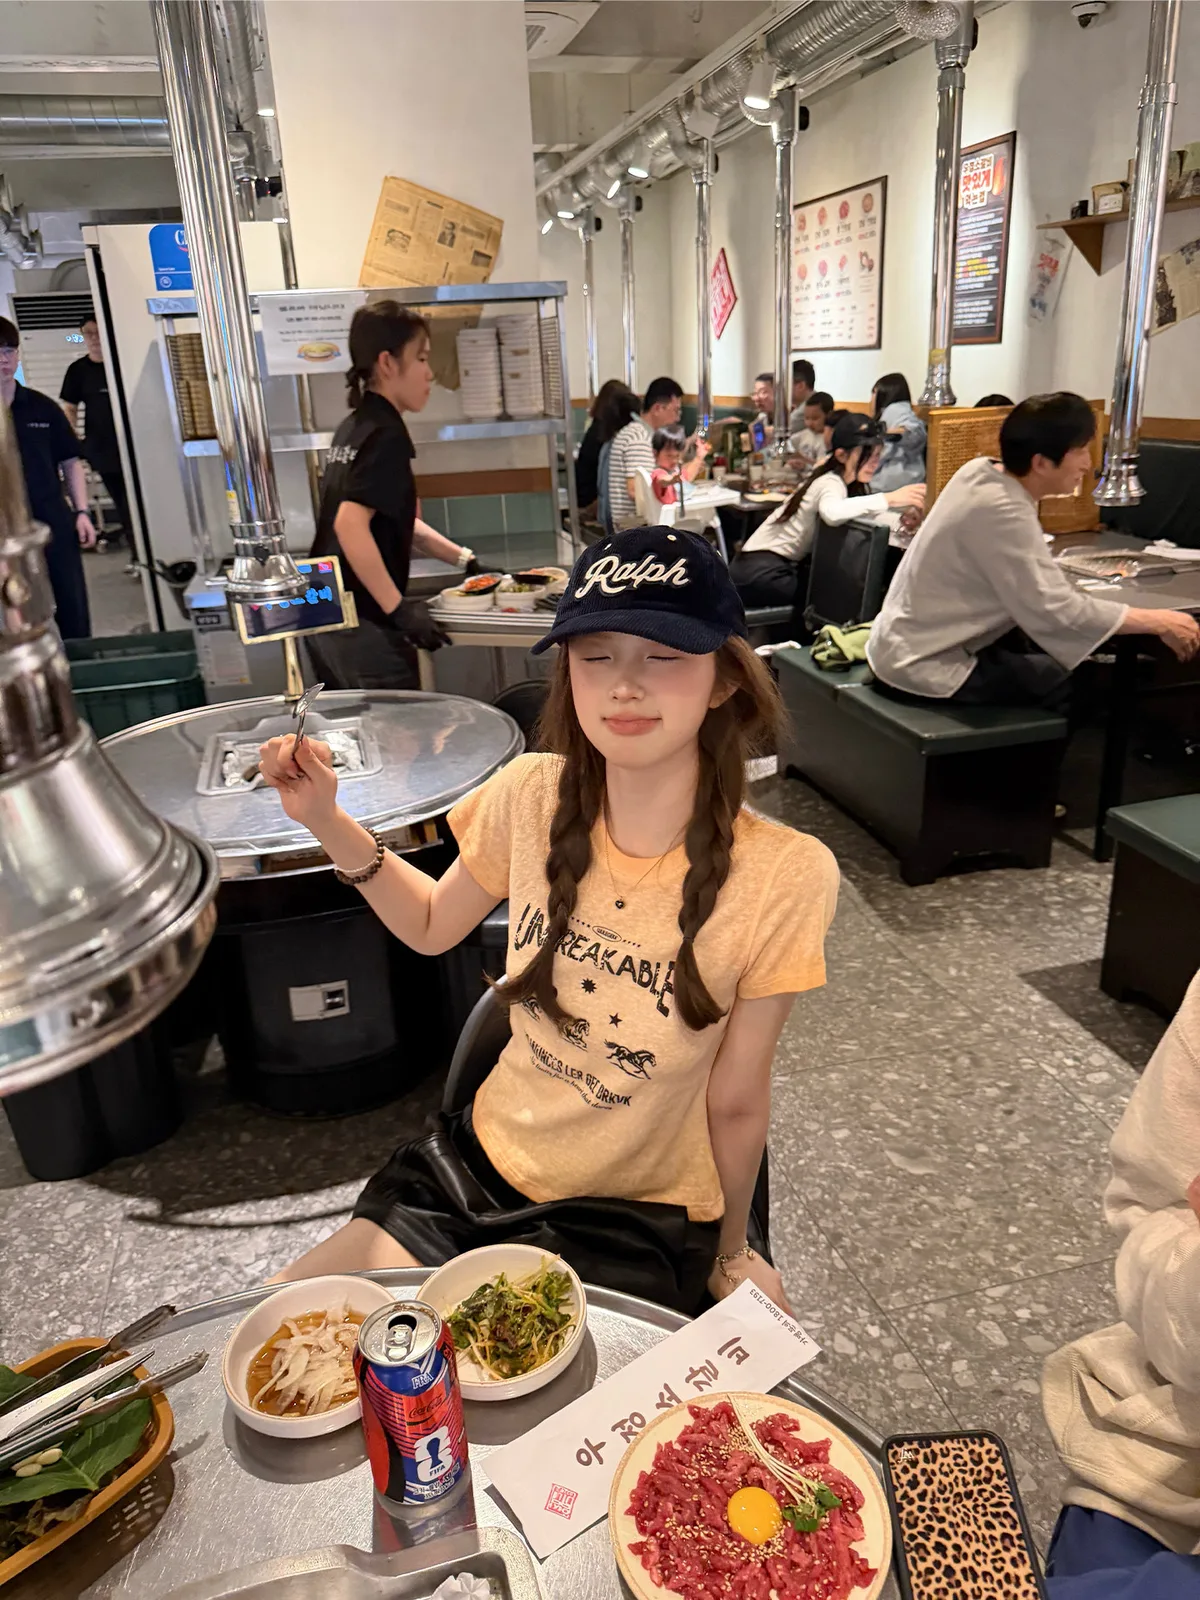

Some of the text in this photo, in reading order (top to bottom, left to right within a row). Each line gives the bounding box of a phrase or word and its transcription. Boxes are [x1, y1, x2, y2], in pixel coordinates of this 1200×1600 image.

[963, 169, 991, 192] 맛있게
[574, 554, 690, 599] Ralph
[515, 902, 676, 1018] UNREAKABLE
[749, 1288, 784, 1322] 1800-7193
[411, 1372, 434, 1390] FRA
[575, 1336, 751, 1467] 우정소갈비
[429, 1464, 446, 1477] FIFA
